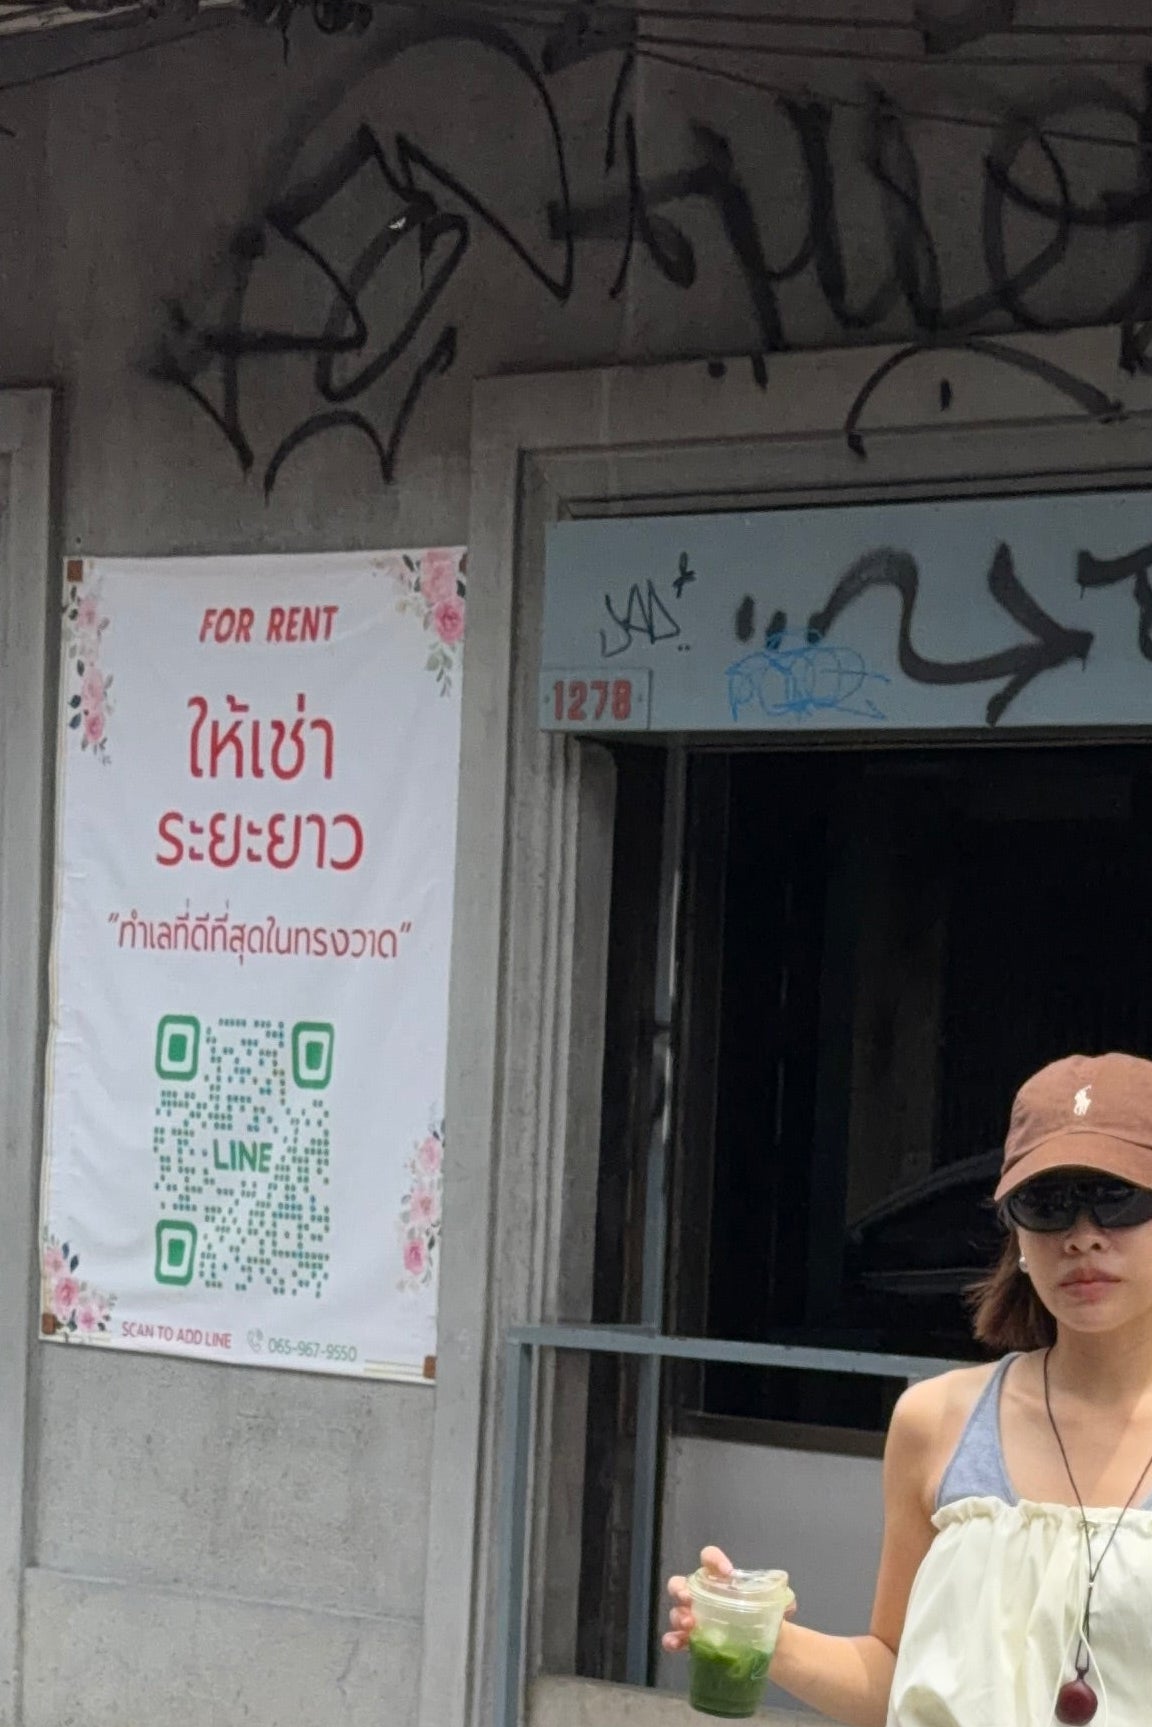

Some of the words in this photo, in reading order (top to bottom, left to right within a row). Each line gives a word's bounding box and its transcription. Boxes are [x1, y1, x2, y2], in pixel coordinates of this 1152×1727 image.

[199, 607, 255, 644] FOR
[266, 605, 339, 643] RENT
[553, 679, 632, 721] 1278
[187, 692, 336, 781] ให้เช่า
[156, 811, 365, 871] ระยะยาว
[213, 1138, 273, 1174] LINE
[121, 1321, 154, 1338] SCAN
[157, 1325, 174, 1342] TO
[176, 1328, 203, 1345] ADD
[205, 1331, 232, 1349] LINE
